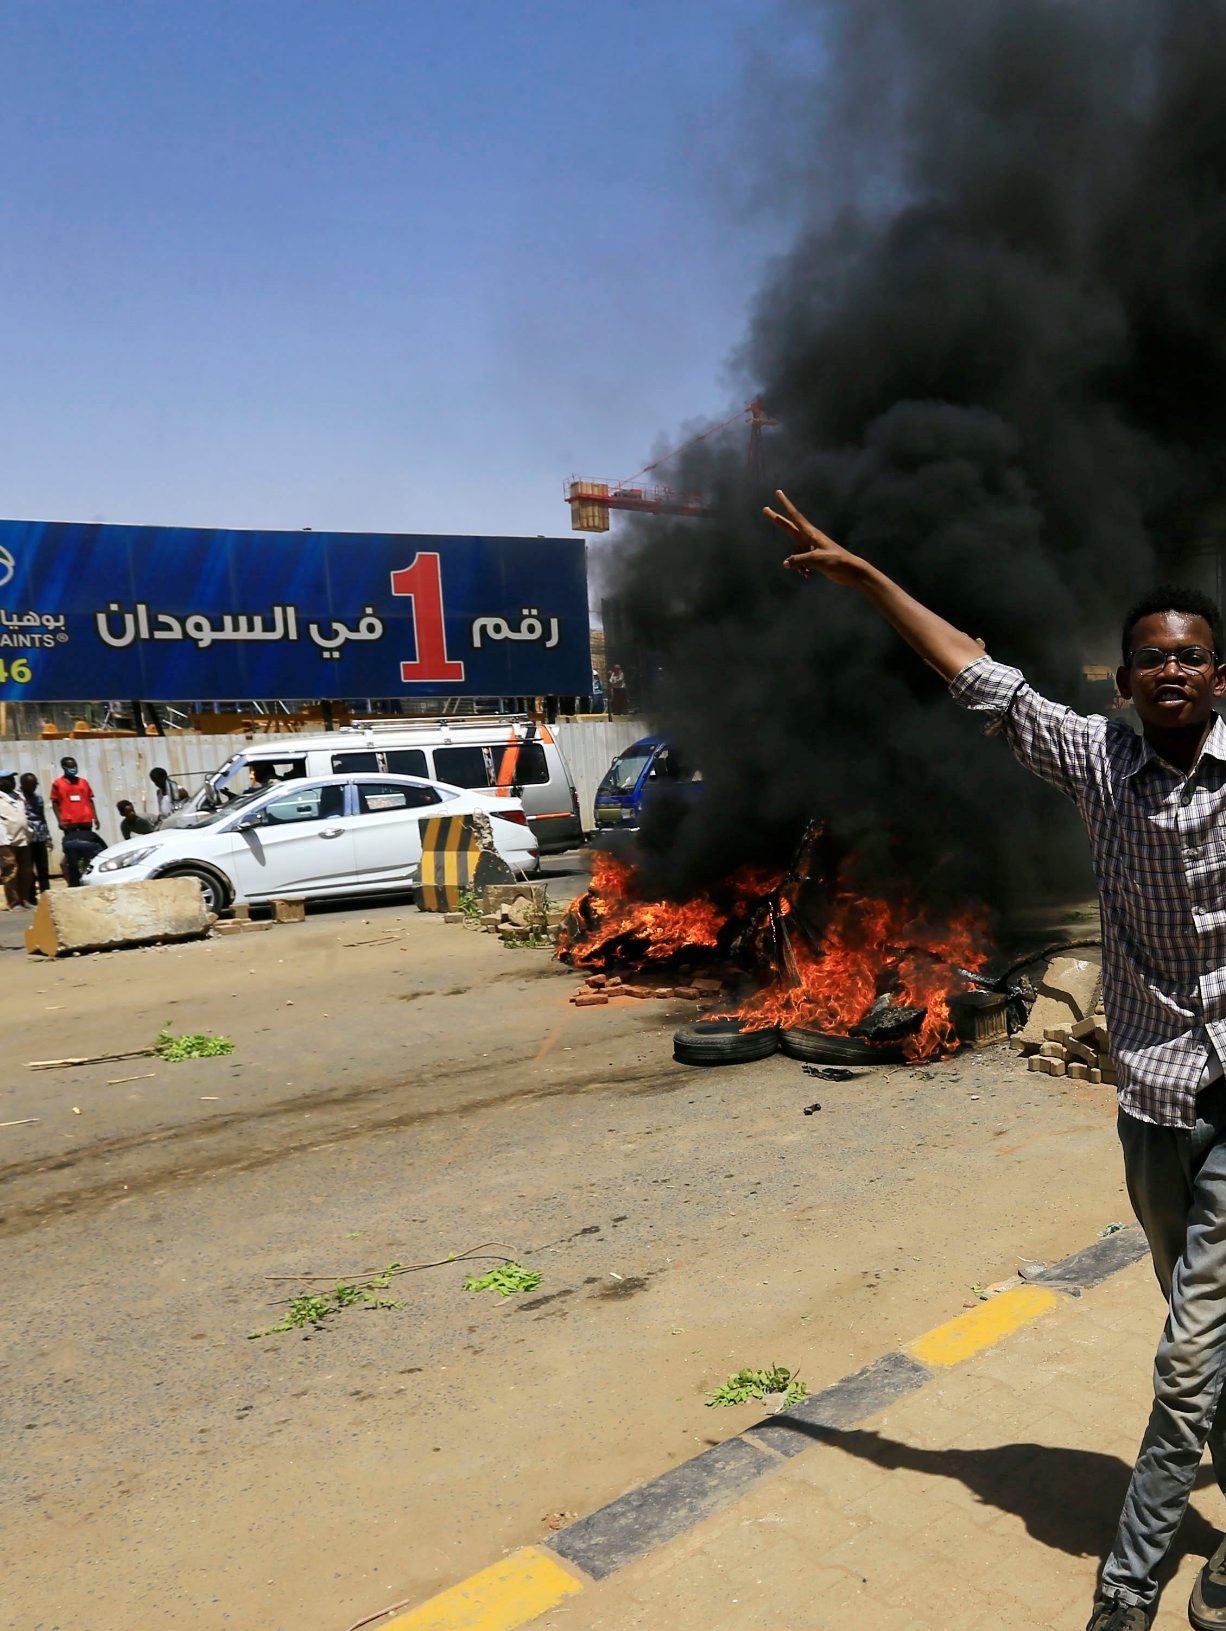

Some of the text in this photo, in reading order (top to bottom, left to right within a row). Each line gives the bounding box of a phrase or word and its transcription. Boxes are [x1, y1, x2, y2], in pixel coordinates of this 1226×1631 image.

[96, 551, 560, 682] رقم 1 في السودان
